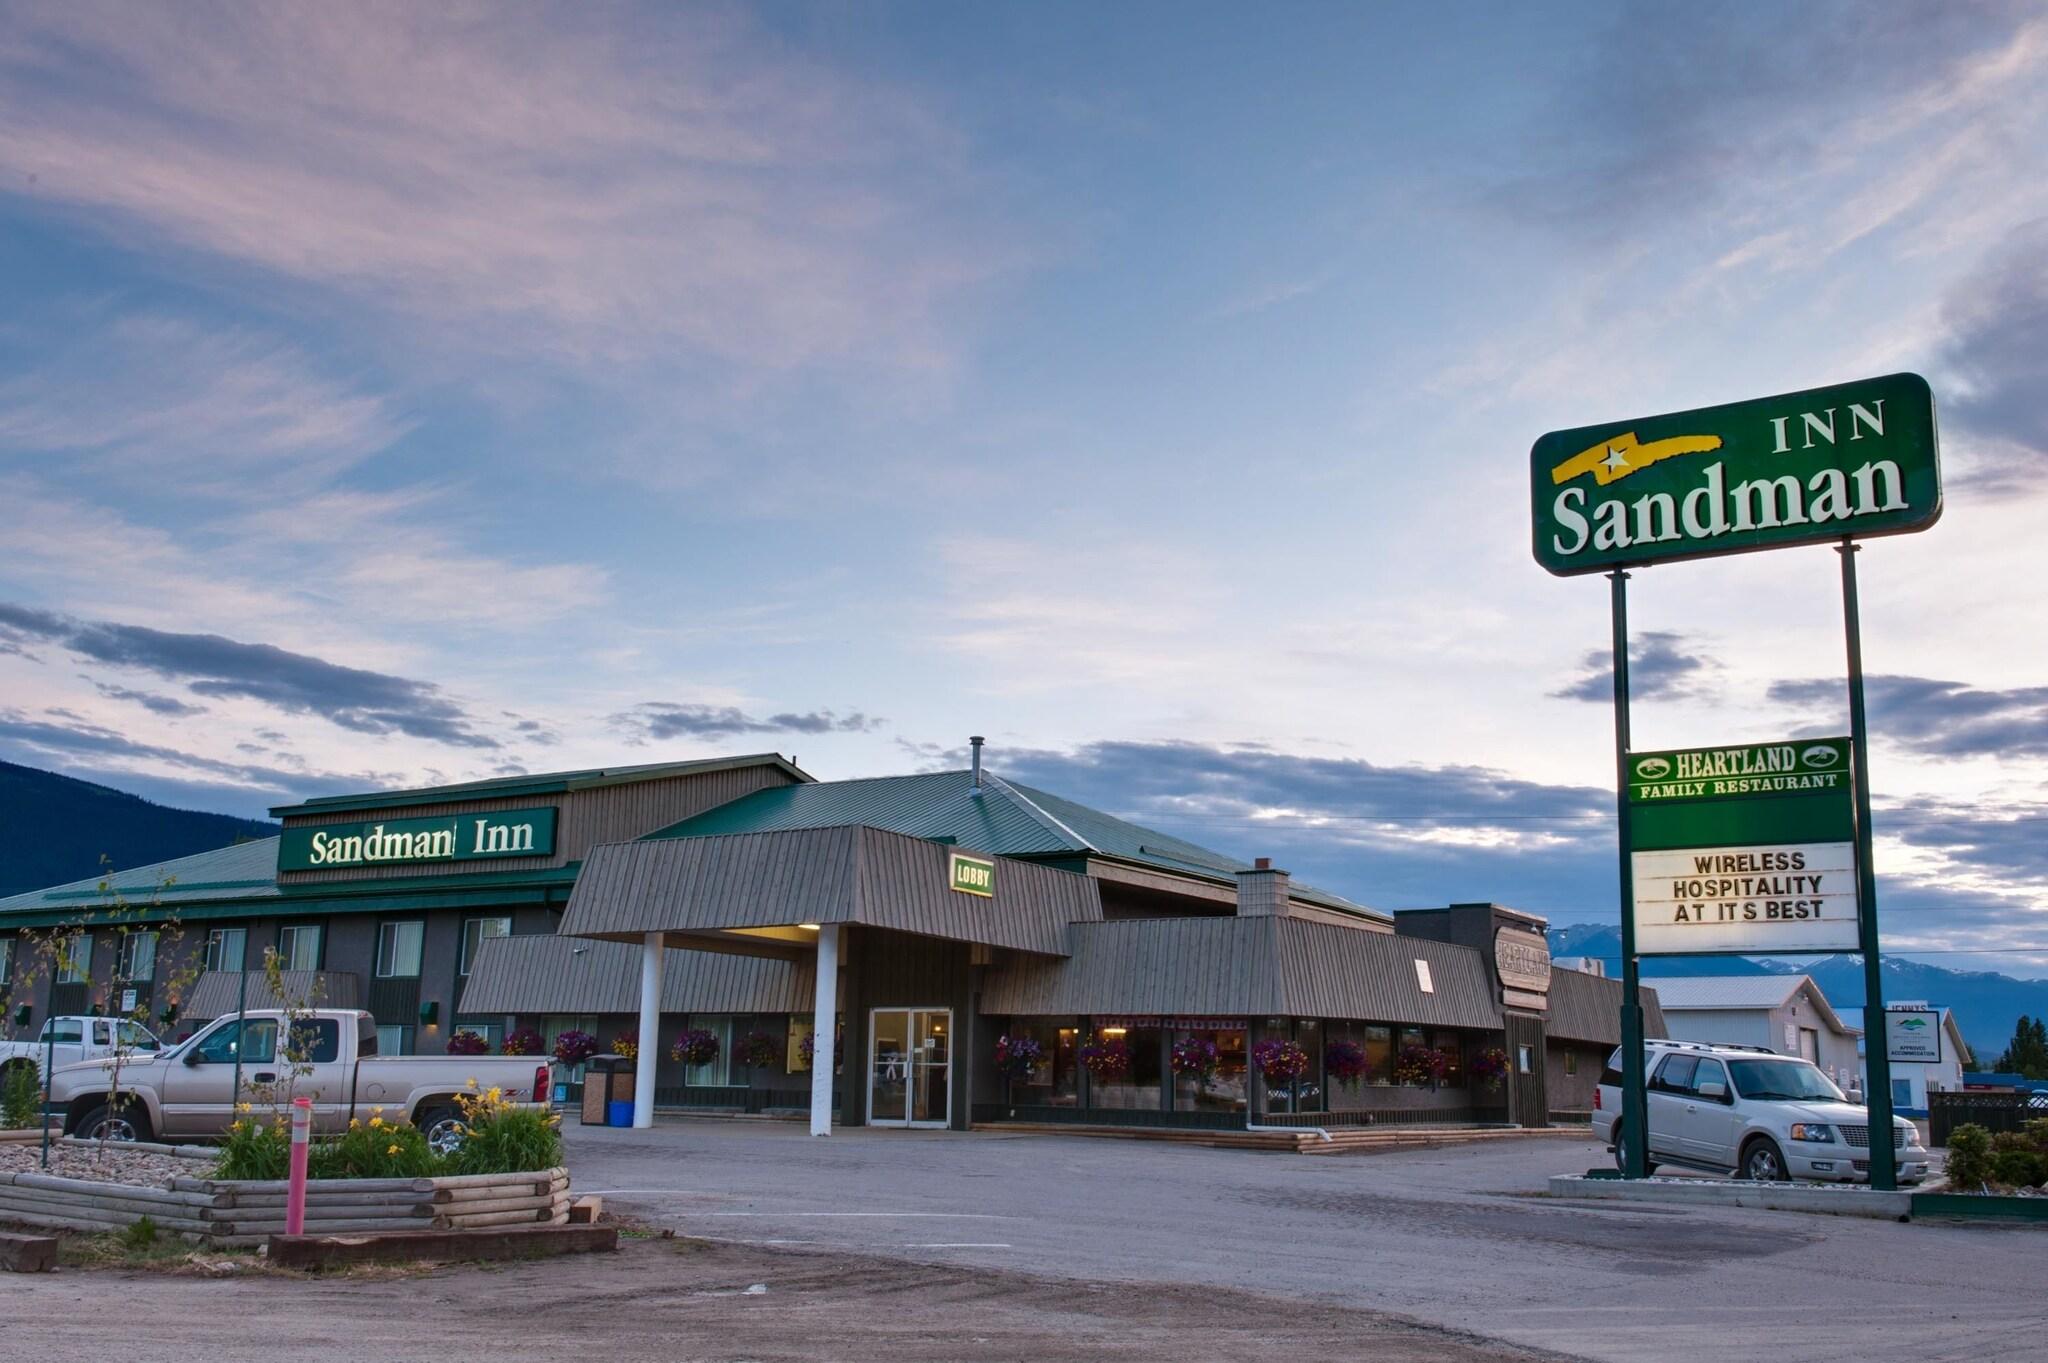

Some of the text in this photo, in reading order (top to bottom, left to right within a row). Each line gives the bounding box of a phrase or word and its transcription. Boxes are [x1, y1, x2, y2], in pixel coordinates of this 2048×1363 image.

[1769, 400, 1886, 454] INN
[1553, 460, 1909, 555] Sandman
[1676, 746, 1796, 779] HEARTLAND
[1641, 774, 1838, 799] FAMILY RESTAURANT
[310, 819, 534, 864] Sandman Inn
[957, 864, 990, 887] LOBBY
[1694, 852, 1806, 874] WIRELESS
[1674, 875, 1823, 898] HOSPITALITY
[1674, 904, 1705, 922] AT
[1766, 900, 1824, 919] BEST
